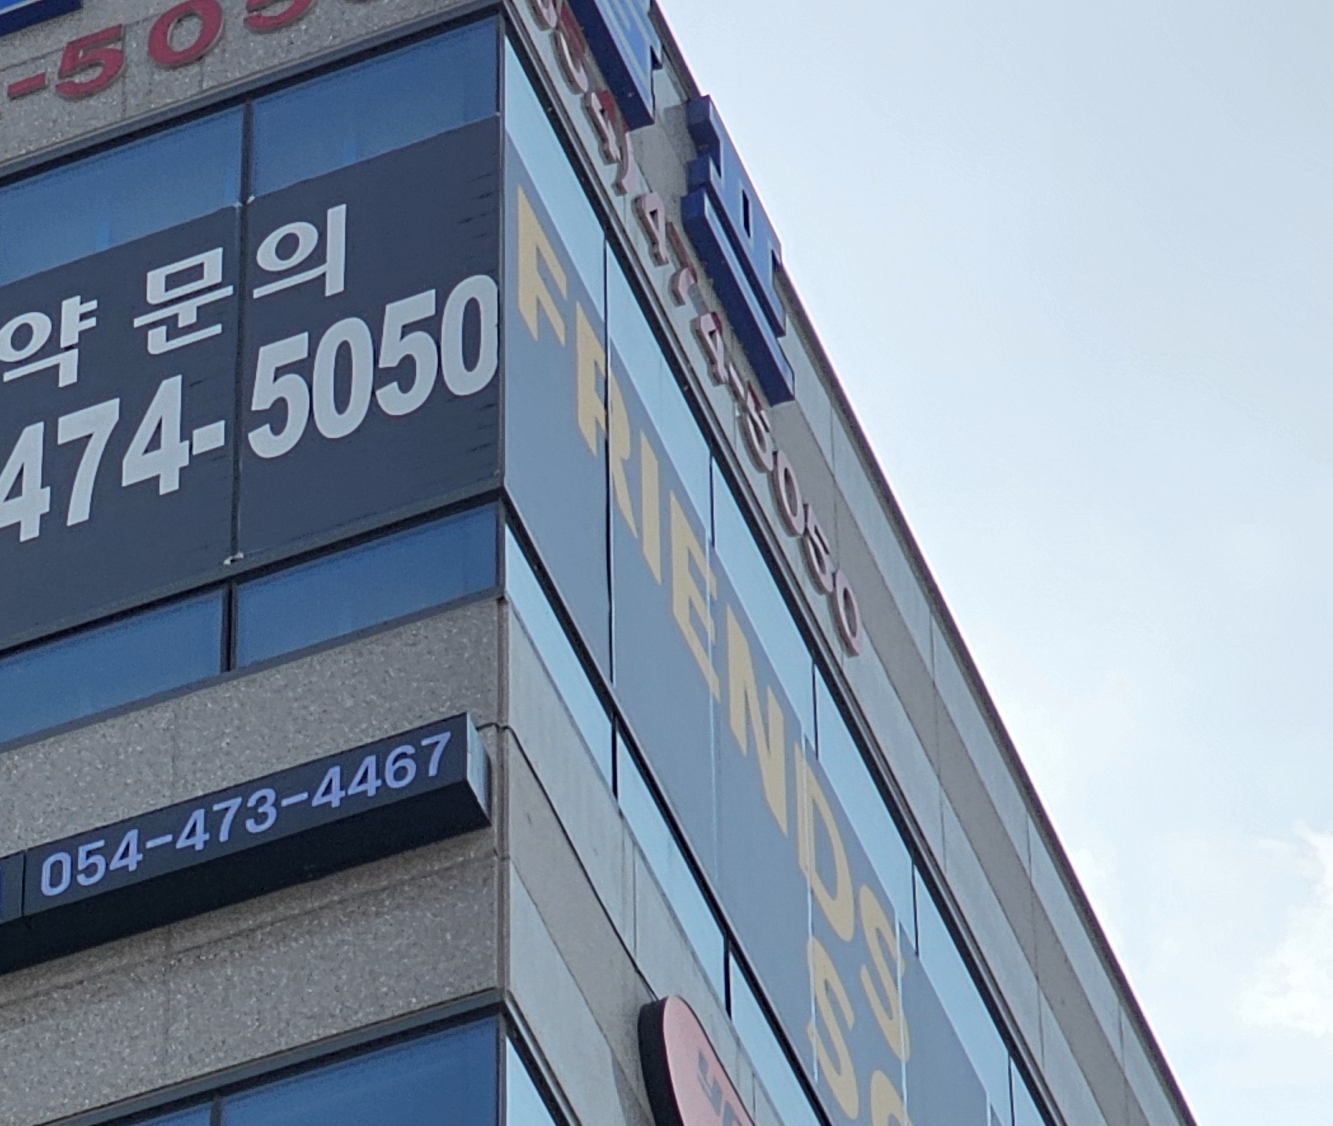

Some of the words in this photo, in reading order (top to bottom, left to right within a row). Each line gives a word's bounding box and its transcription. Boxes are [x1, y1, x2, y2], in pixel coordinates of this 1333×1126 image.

[134, 203, 347, 356] 문의
[517, 186, 911, 1066] FRIENDS
[39, 731, 452, 898] 054-473-4467
